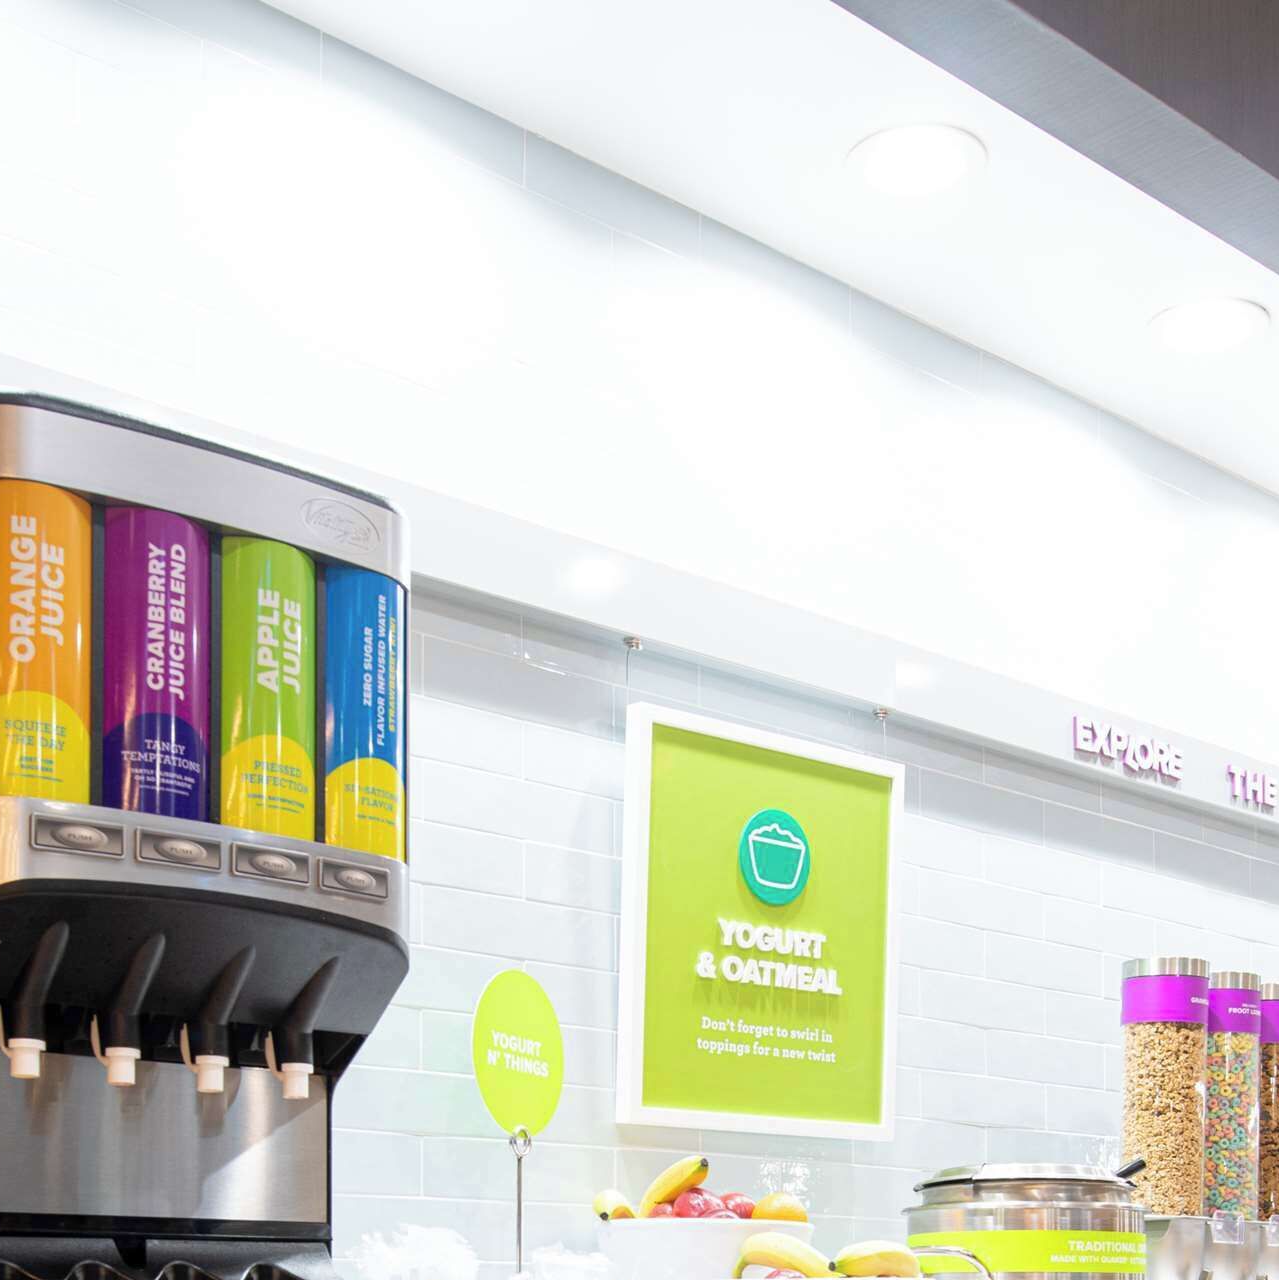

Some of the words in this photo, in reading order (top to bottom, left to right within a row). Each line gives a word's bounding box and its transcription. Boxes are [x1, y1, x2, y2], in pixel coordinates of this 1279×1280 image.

[9, 515, 37, 663] ORANGE
[40, 542, 64, 646] JUICE
[170, 544, 186, 624] BLEND
[147, 543, 166, 690] CRANBERRY
[378, 594, 387, 637] WATER
[257, 588, 280, 693] APPLE
[283, 598, 301, 695] JUICE
[363, 627, 373, 670] SUGAR
[169, 630, 185, 700] JUICE
[377, 640, 386, 694] INFUSED
[363, 673, 373, 707] ZERO
[377, 699, 385, 746] FLAVOR
[121, 750, 201, 773] TEMPTATIONS
[144, 739, 186, 755] TANGY
[1073, 714, 1184, 780] EXPLORE
[1227, 764, 1279, 808] THE
[717, 917, 827, 959] YOGURT
[695, 951, 717, 979] &
[721, 955, 843, 996] OATMEAL
[491, 1028, 543, 1057] YOGURT
[696, 1037, 750, 1056] toppings
[753, 1042, 770, 1056] for
[782, 1048, 805, 1060] new
[807, 1048, 837, 1063] twist
[701, 1016, 735, 1033] Don't
[737, 1019, 774, 1038] forget
[776, 1026, 788, 1038] to
[790, 1028, 819, 1042] swirl
[821, 1029, 833, 1043] in
[487, 1048, 500, 1067] N'
[504, 1052, 549, 1078] THINGS
[1050, 1254, 1075, 1263] MADE
[1068, 1240, 1136, 1253] TRADITIONAL
